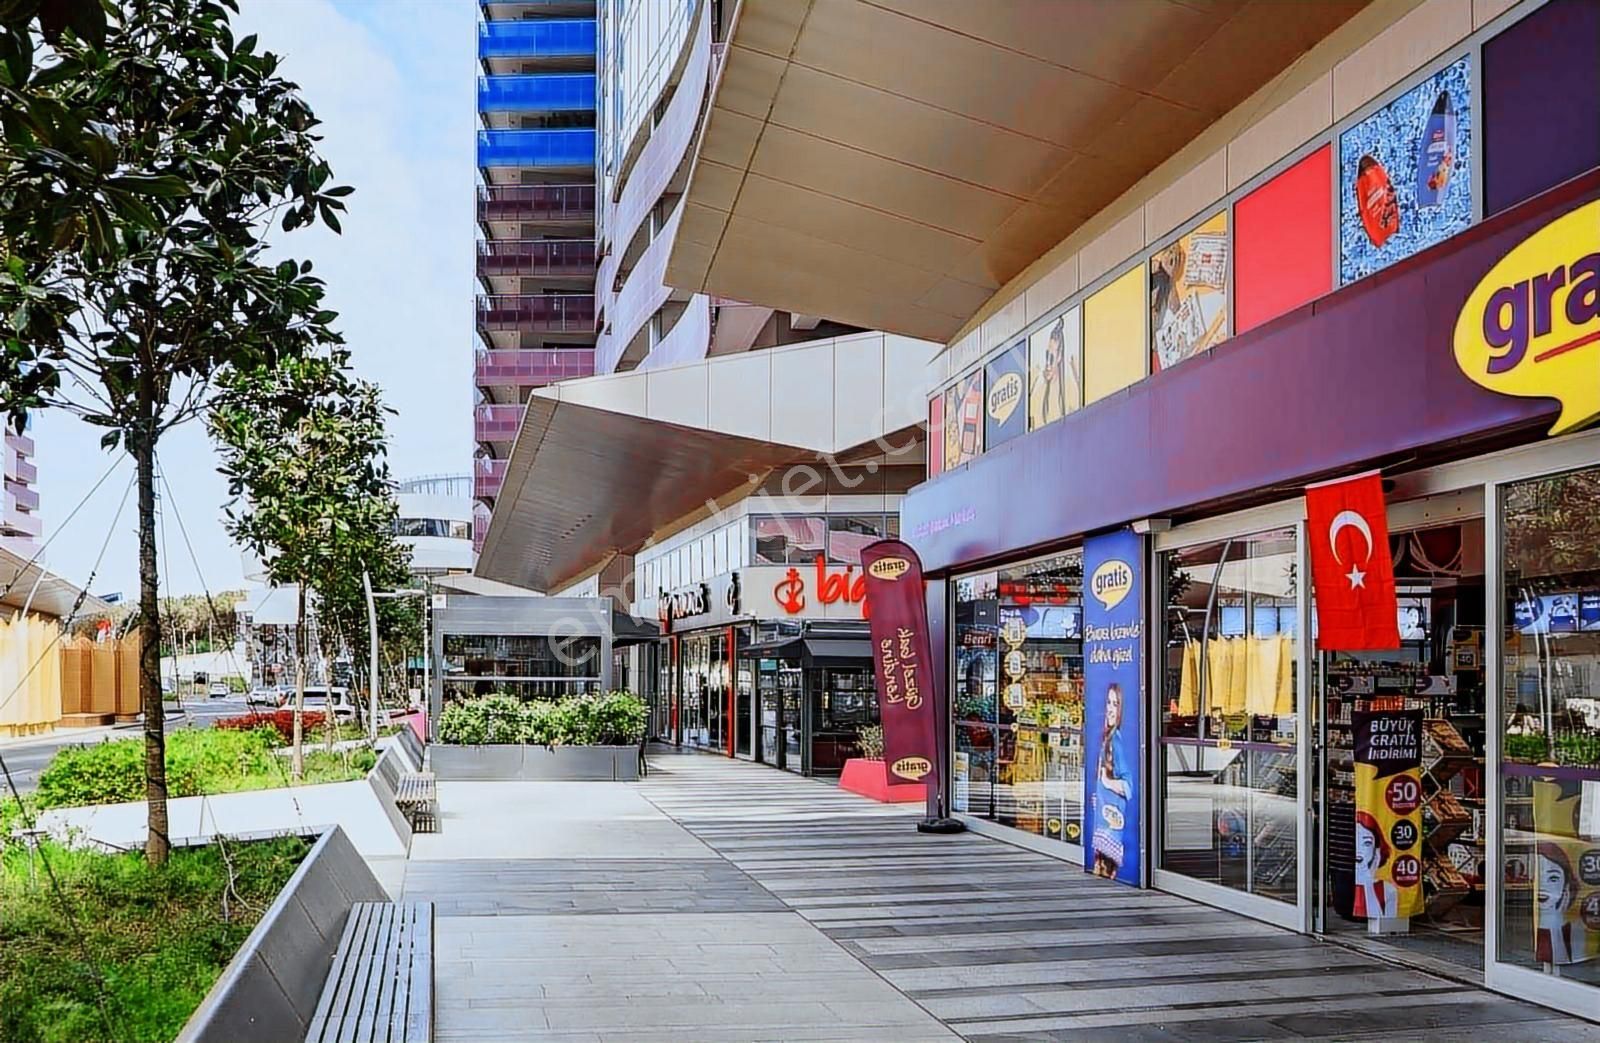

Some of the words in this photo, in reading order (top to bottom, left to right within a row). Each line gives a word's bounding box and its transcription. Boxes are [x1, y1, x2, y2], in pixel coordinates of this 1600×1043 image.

[1482, 252, 1600, 374] gra
[991, 377, 1019, 413] gratis
[1096, 565, 1128, 595] gratis
[1370, 717, 1415, 733] BÜYÜK
